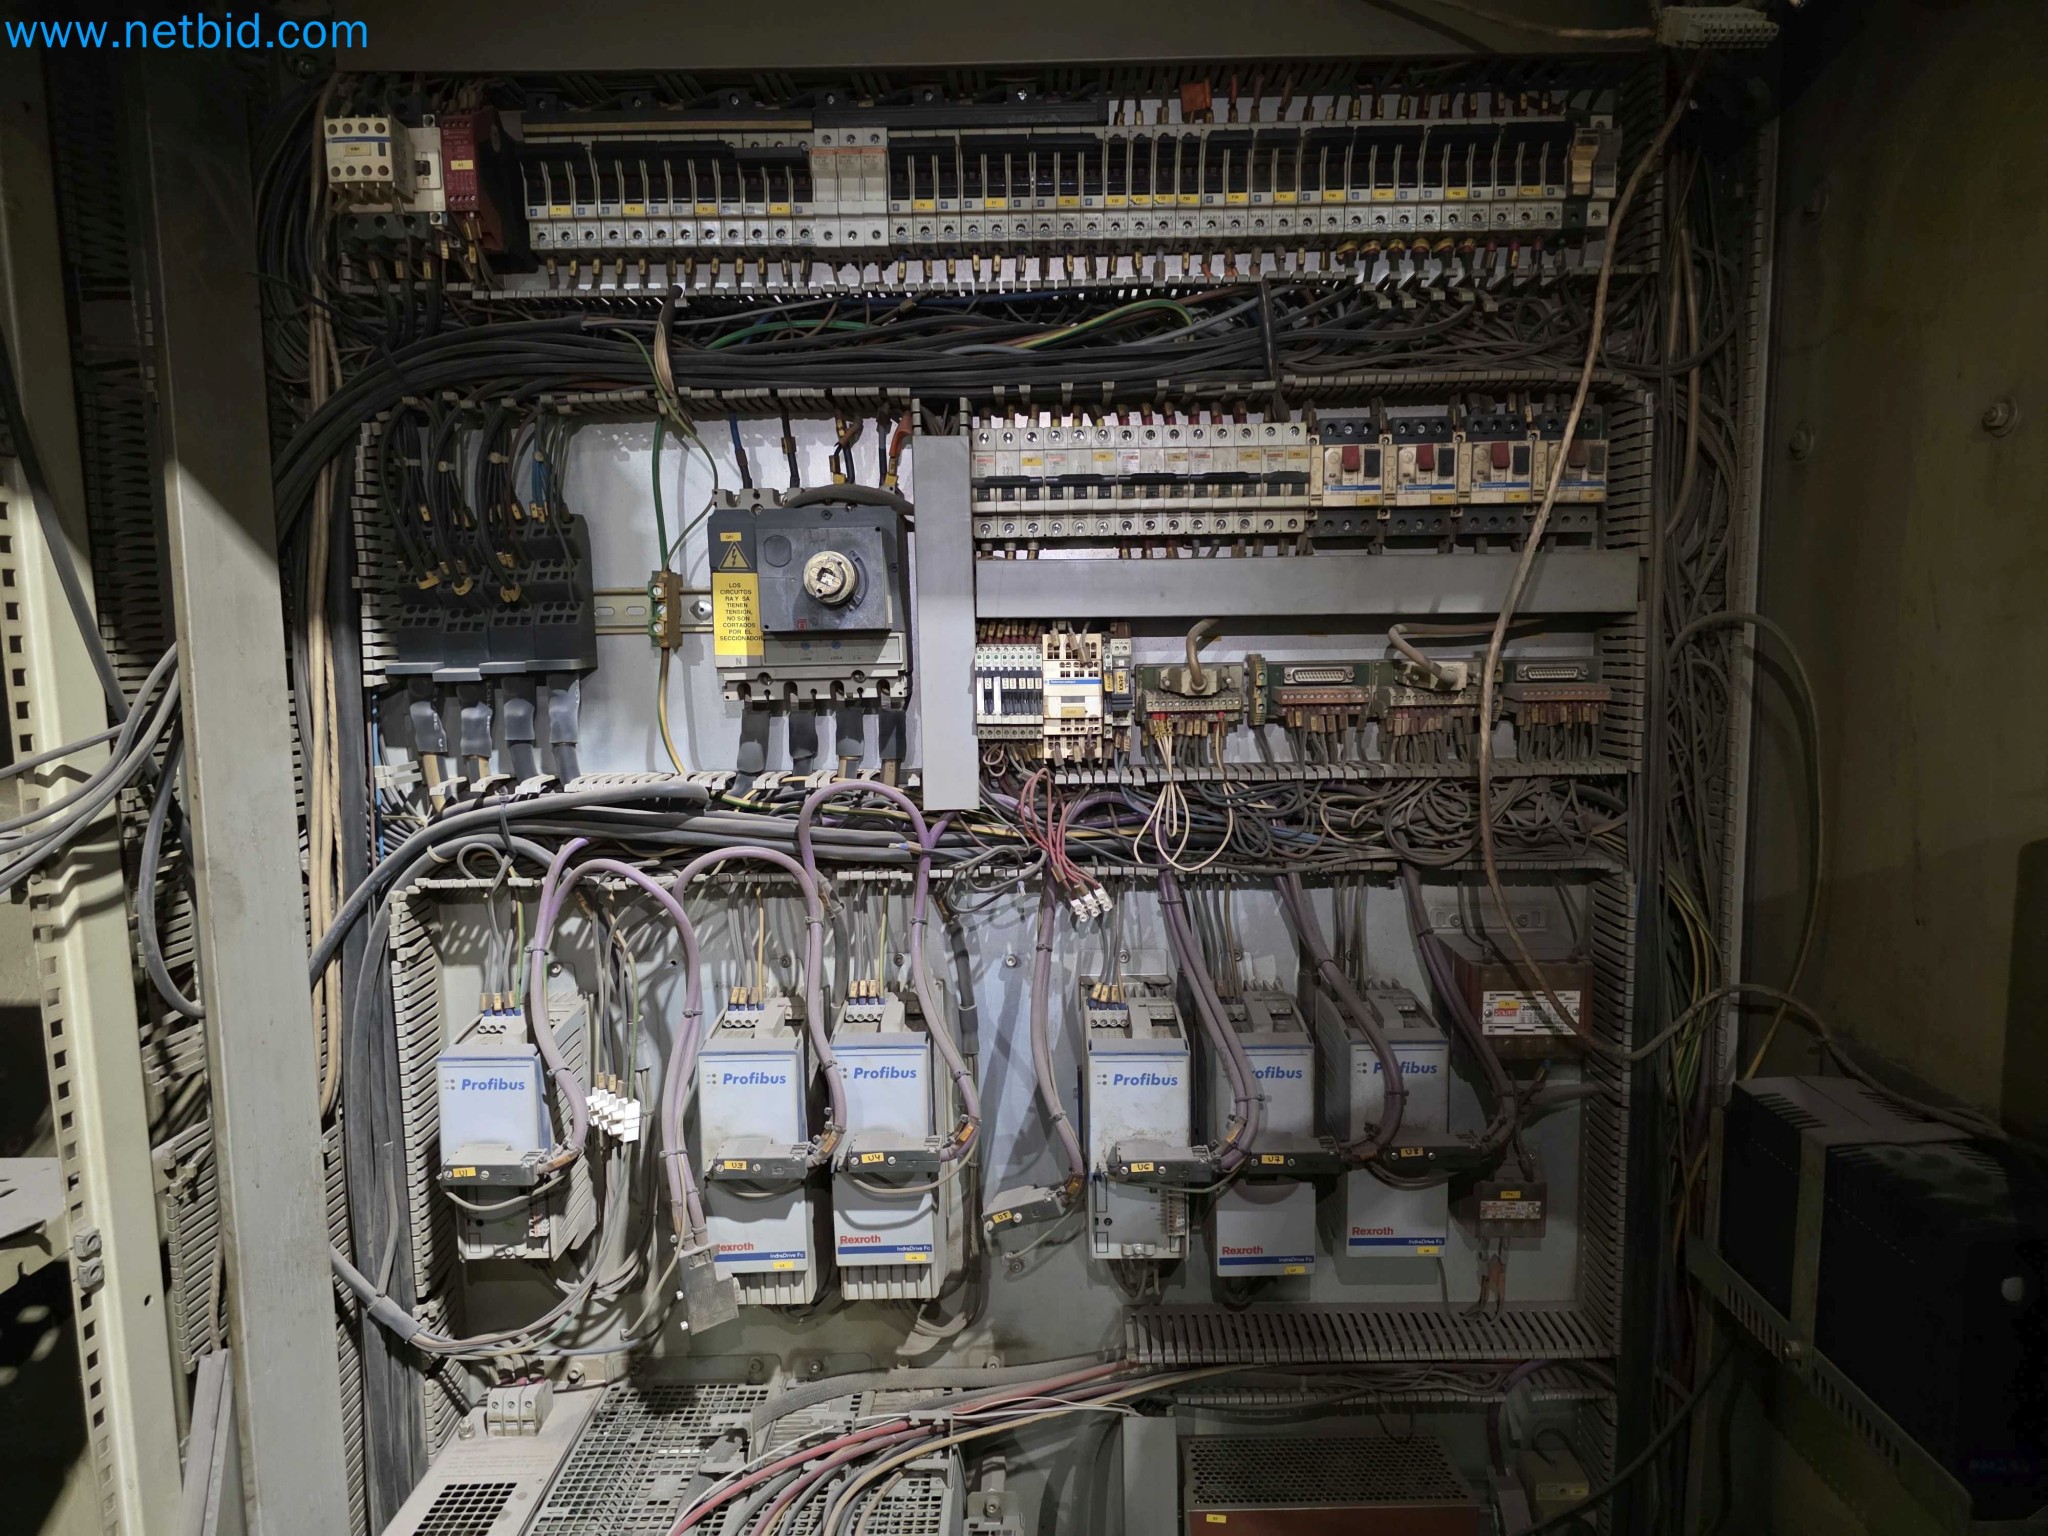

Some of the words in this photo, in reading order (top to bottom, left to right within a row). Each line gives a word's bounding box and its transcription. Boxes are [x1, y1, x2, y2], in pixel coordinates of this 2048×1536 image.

[853, 1066, 917, 1080] Profibus
[1252, 1066, 1303, 1080] ofibus
[1373, 1061, 1437, 1074] Pfibus
[461, 1078, 525, 1091] Profibus
[722, 1071, 787, 1086] Profibus
[1113, 1073, 1178, 1086] Profibus
[867, 1154, 881, 1162] U4
[1352, 1227, 1394, 1235] Rexroth
[840, 1235, 881, 1245] Rexroth
[1222, 1246, 1263, 1255] Rexroth
